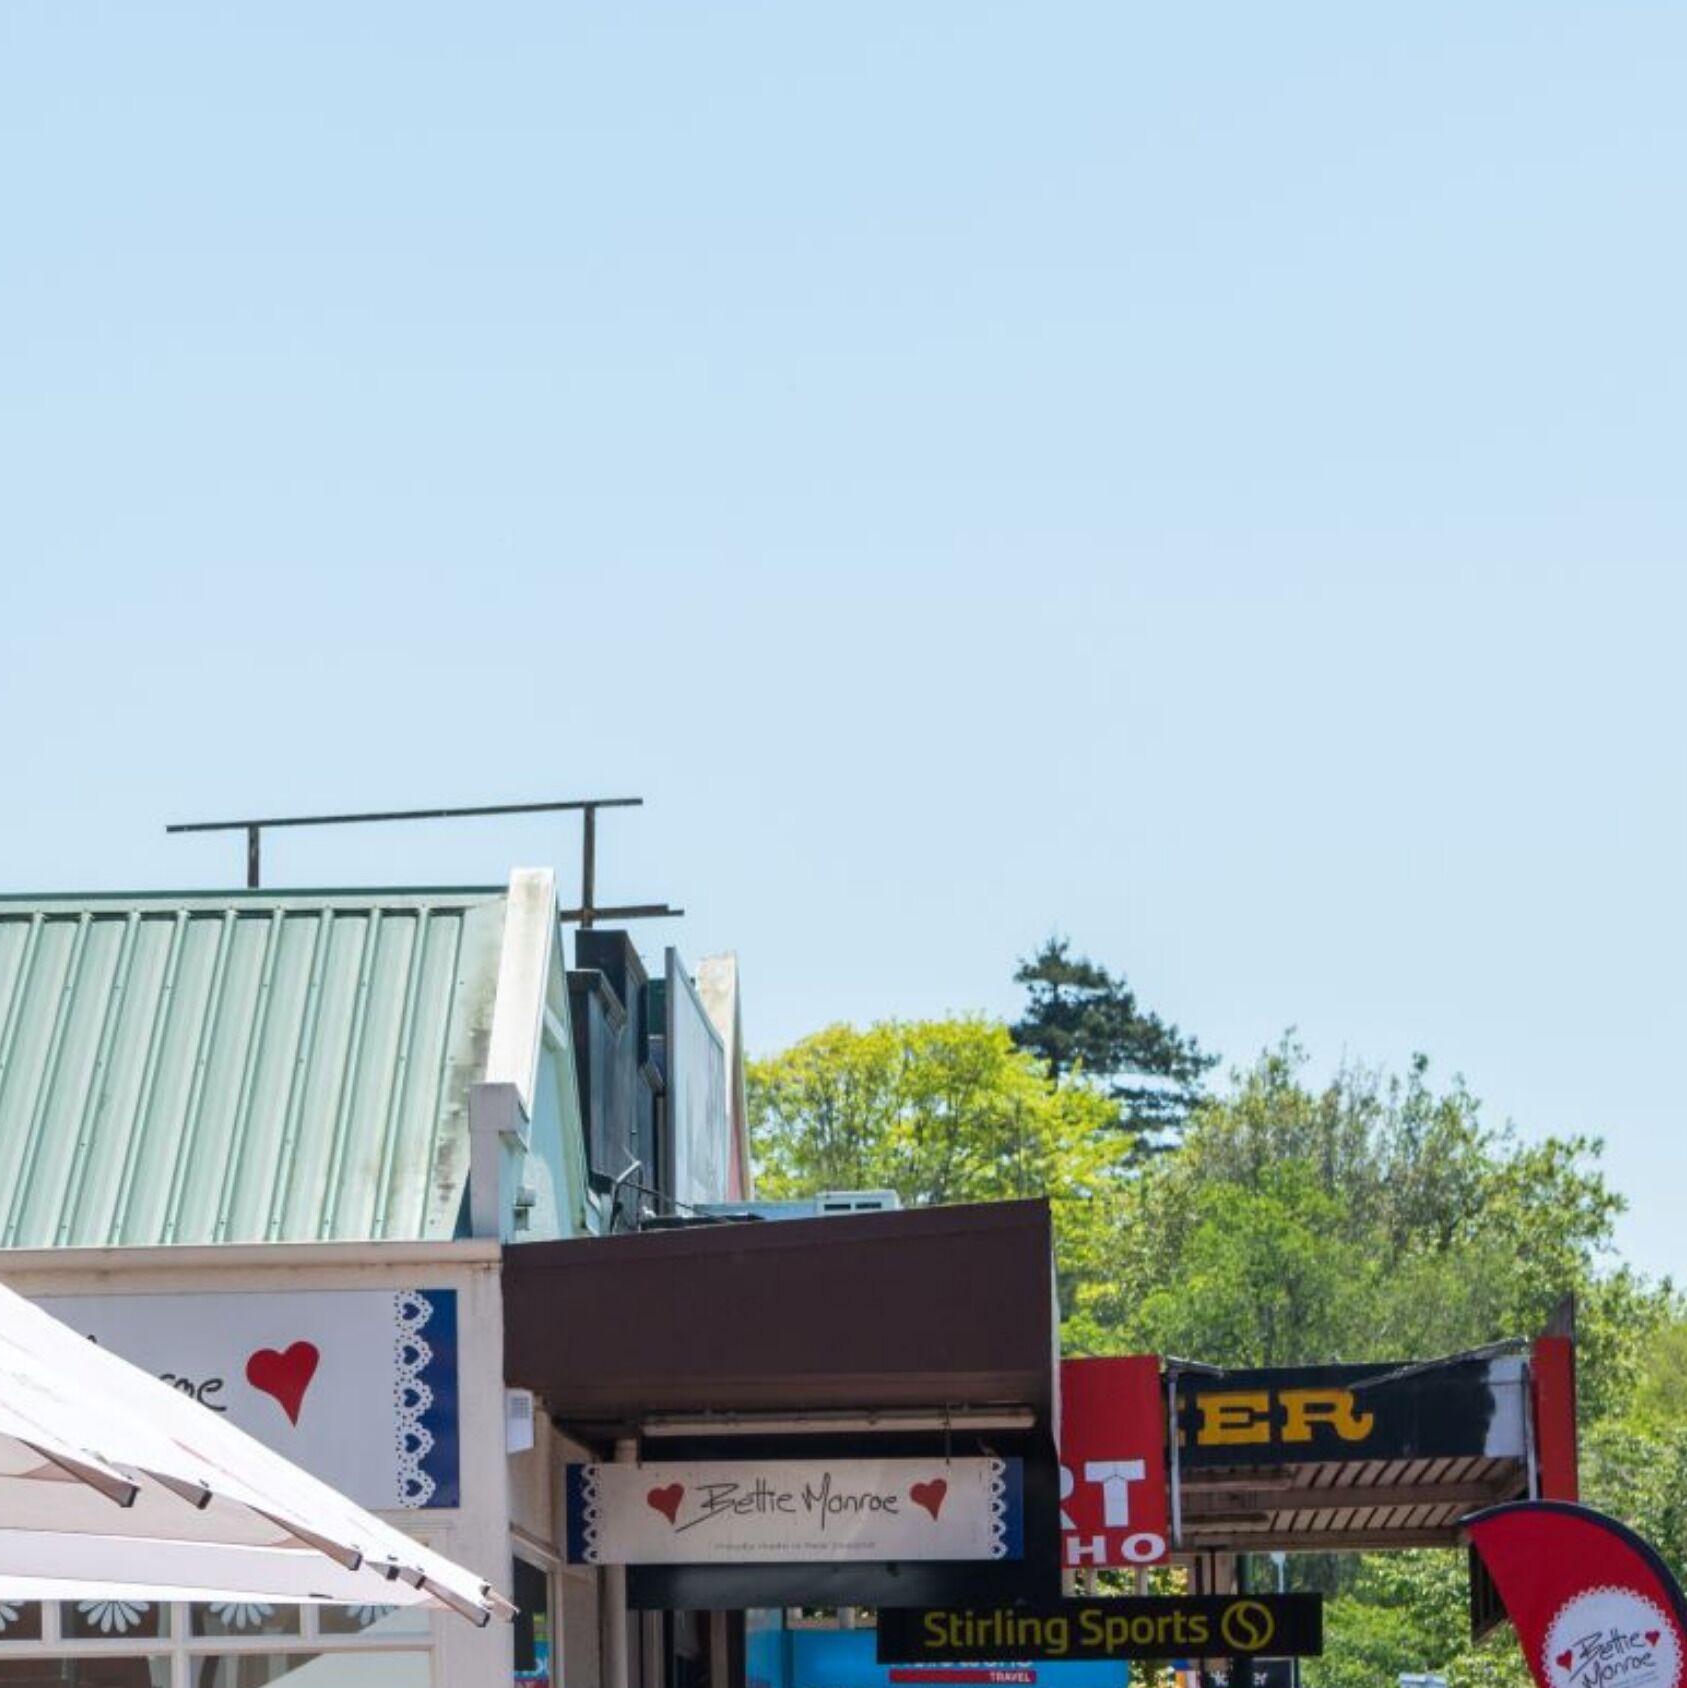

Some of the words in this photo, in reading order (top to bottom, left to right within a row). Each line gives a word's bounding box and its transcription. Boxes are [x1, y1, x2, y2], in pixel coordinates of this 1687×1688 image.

[675, 1477, 796, 1533] Bettie
[801, 1472, 900, 1531] Monroe
[923, 1611, 1069, 1654] Stirling
[1080, 1608, 1210, 1651] Sports
[1569, 1626, 1647, 1682] Bettie
[989, 1671, 1032, 1684] TRAVEL
